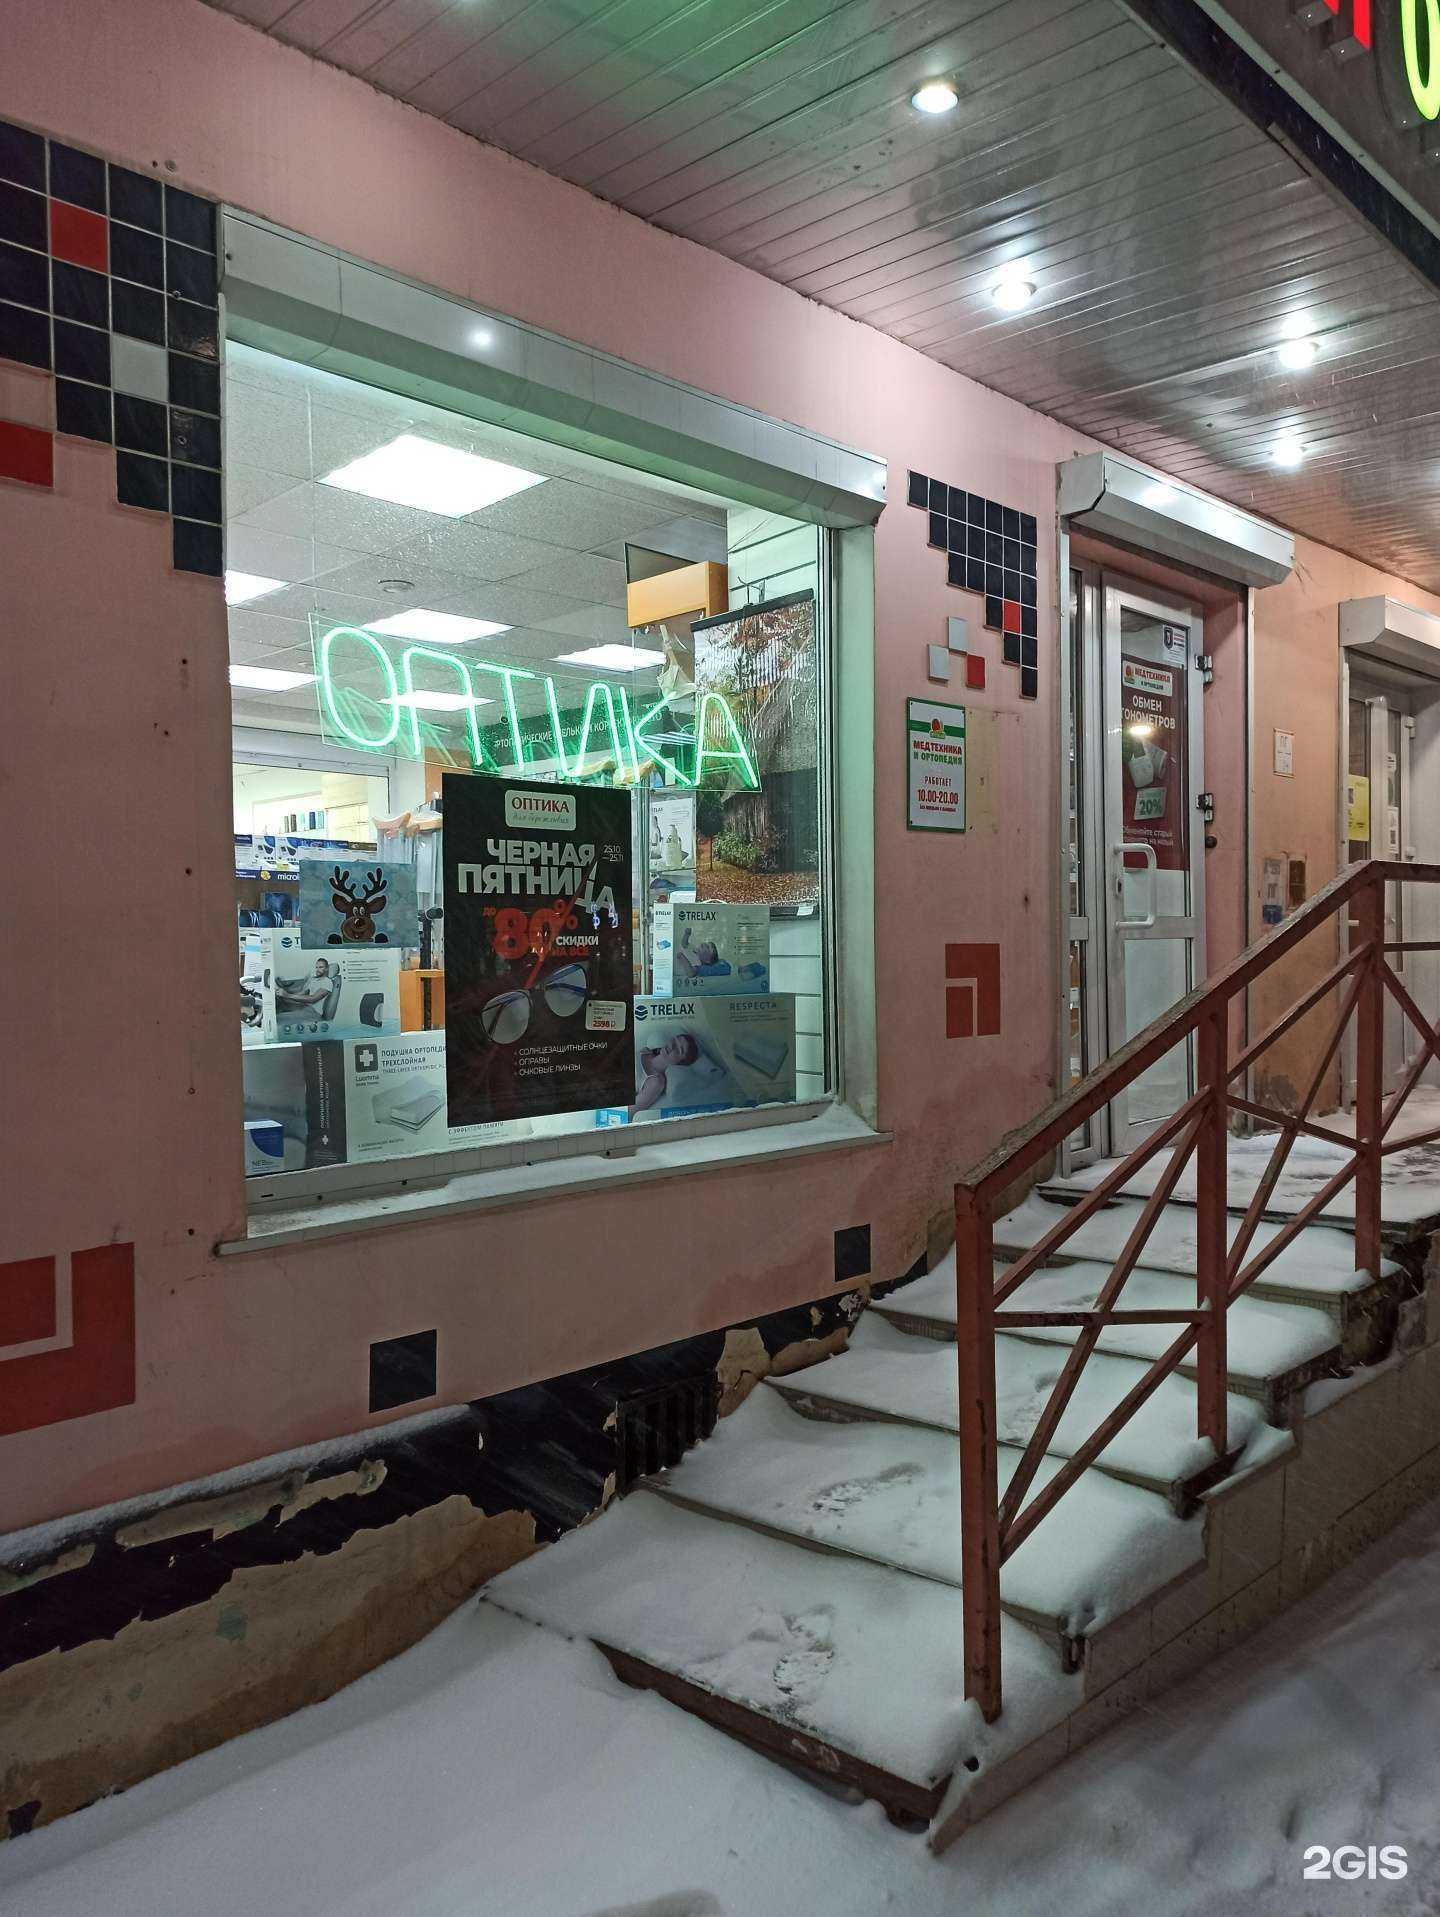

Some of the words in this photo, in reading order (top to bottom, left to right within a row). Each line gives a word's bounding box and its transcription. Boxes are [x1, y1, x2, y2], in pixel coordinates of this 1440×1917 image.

[319, 625, 762, 789] ОПТИКА
[1132, 695, 1162, 712] ОБМЕН
[1122, 707, 1176, 729] ОНОМЕТРОВ
[913, 740, 963, 755] МЕДТЕХНИКА
[921, 752, 963, 765] ОРТОПЕДИЯ
[924, 776, 952, 787] РАБОТАЕТ
[917, 789, 959, 804] 10.00-20.00
[511, 797, 570, 813] ОПТИКА
[1138, 799, 1163, 816] 20%
[486, 838, 595, 866] ЧЕРНАЯ
[458, 863, 616, 914] ПЯТНИЦА
[685, 911, 717, 921] TRELAX
[555, 936, 599, 947] СКИДКИ
[650, 1003, 695, 1016] TRELAX
[729, 1001, 777, 1011] RESPECTA
[381, 1048, 413, 1057] ПОДУШКА
[519, 1043, 588, 1055] СОЛНЦЕЗАЩИТНЫЕ
[588, 1042, 608, 1050] ОЧКИ
[382, 1057, 426, 1067] ТРЕХСЛОЙНАЯ
[519, 1056, 550, 1066] ОПРАВЫ
[519, 1066, 555, 1076] ОЧКОВЫЕ
[555, 1064, 581, 1072] ЛИНЗЫ
